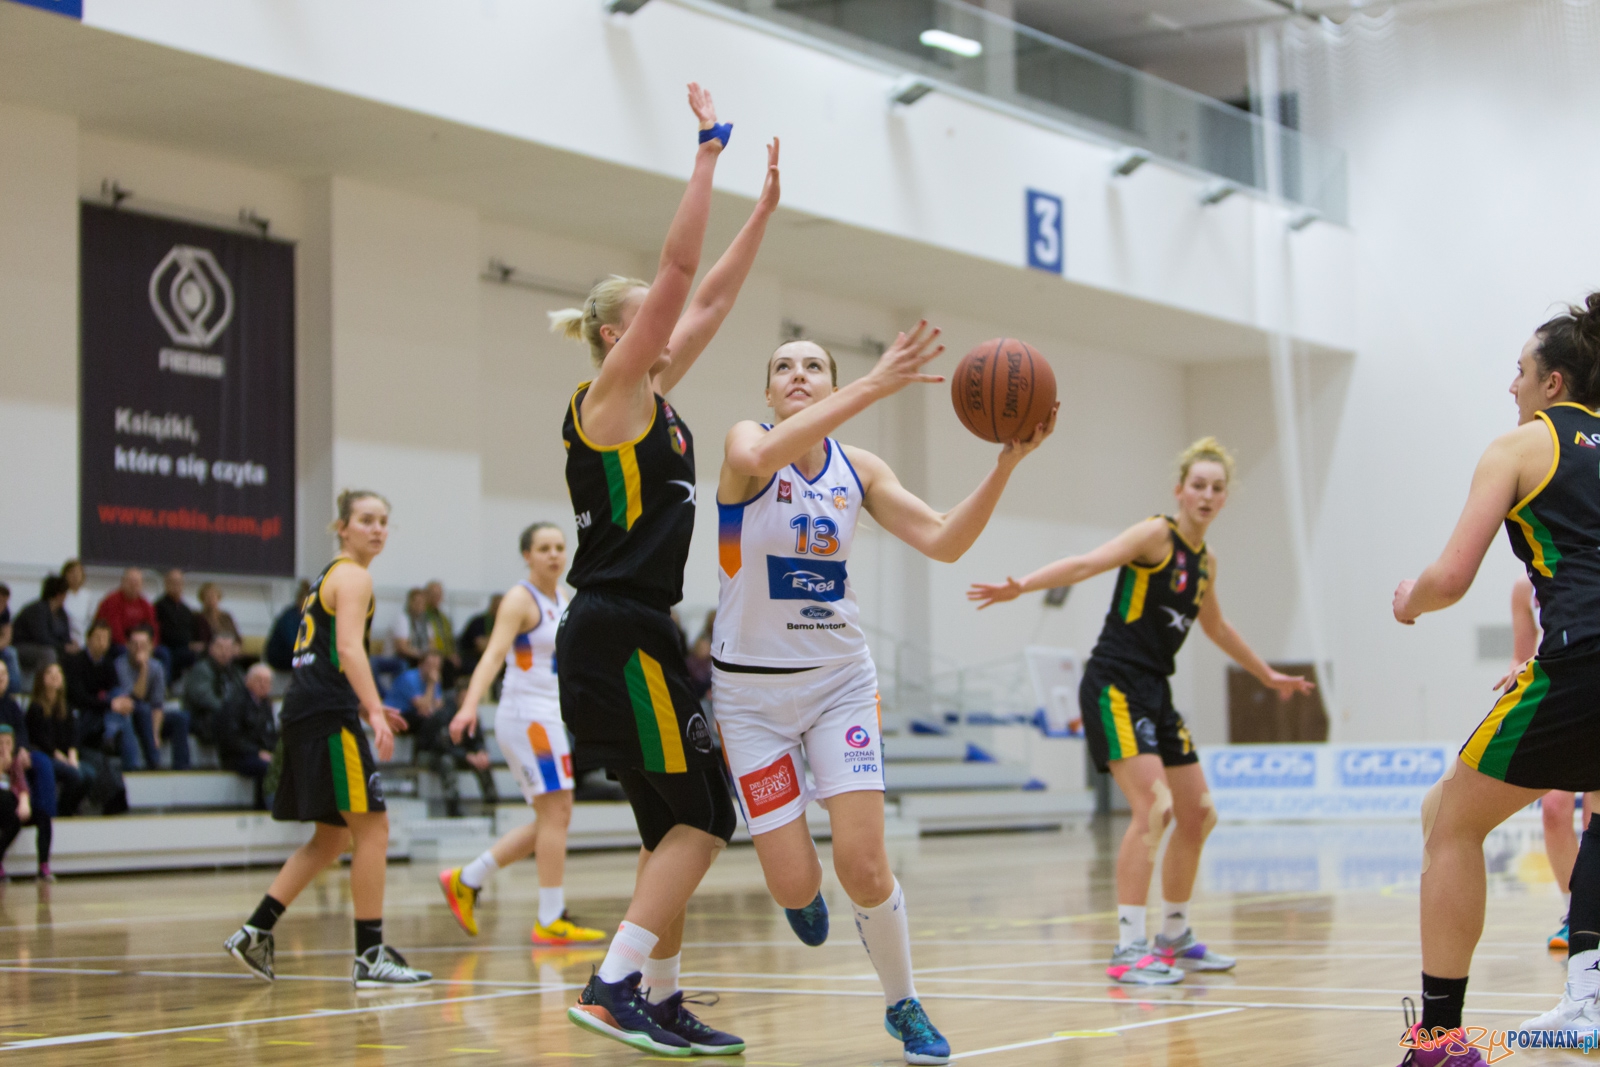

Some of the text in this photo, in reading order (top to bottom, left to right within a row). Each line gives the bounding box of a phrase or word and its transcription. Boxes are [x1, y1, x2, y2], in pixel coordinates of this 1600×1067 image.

[1034, 197, 1059, 264] 3
[1002, 351, 1022, 419] SPALDING
[115, 445, 268, 489] które się czyta
[790, 513, 840, 556] 13
[792, 577, 835, 593] Enea
[816, 622, 846, 630] Motors
[751, 773, 791, 802] SZPIKU
